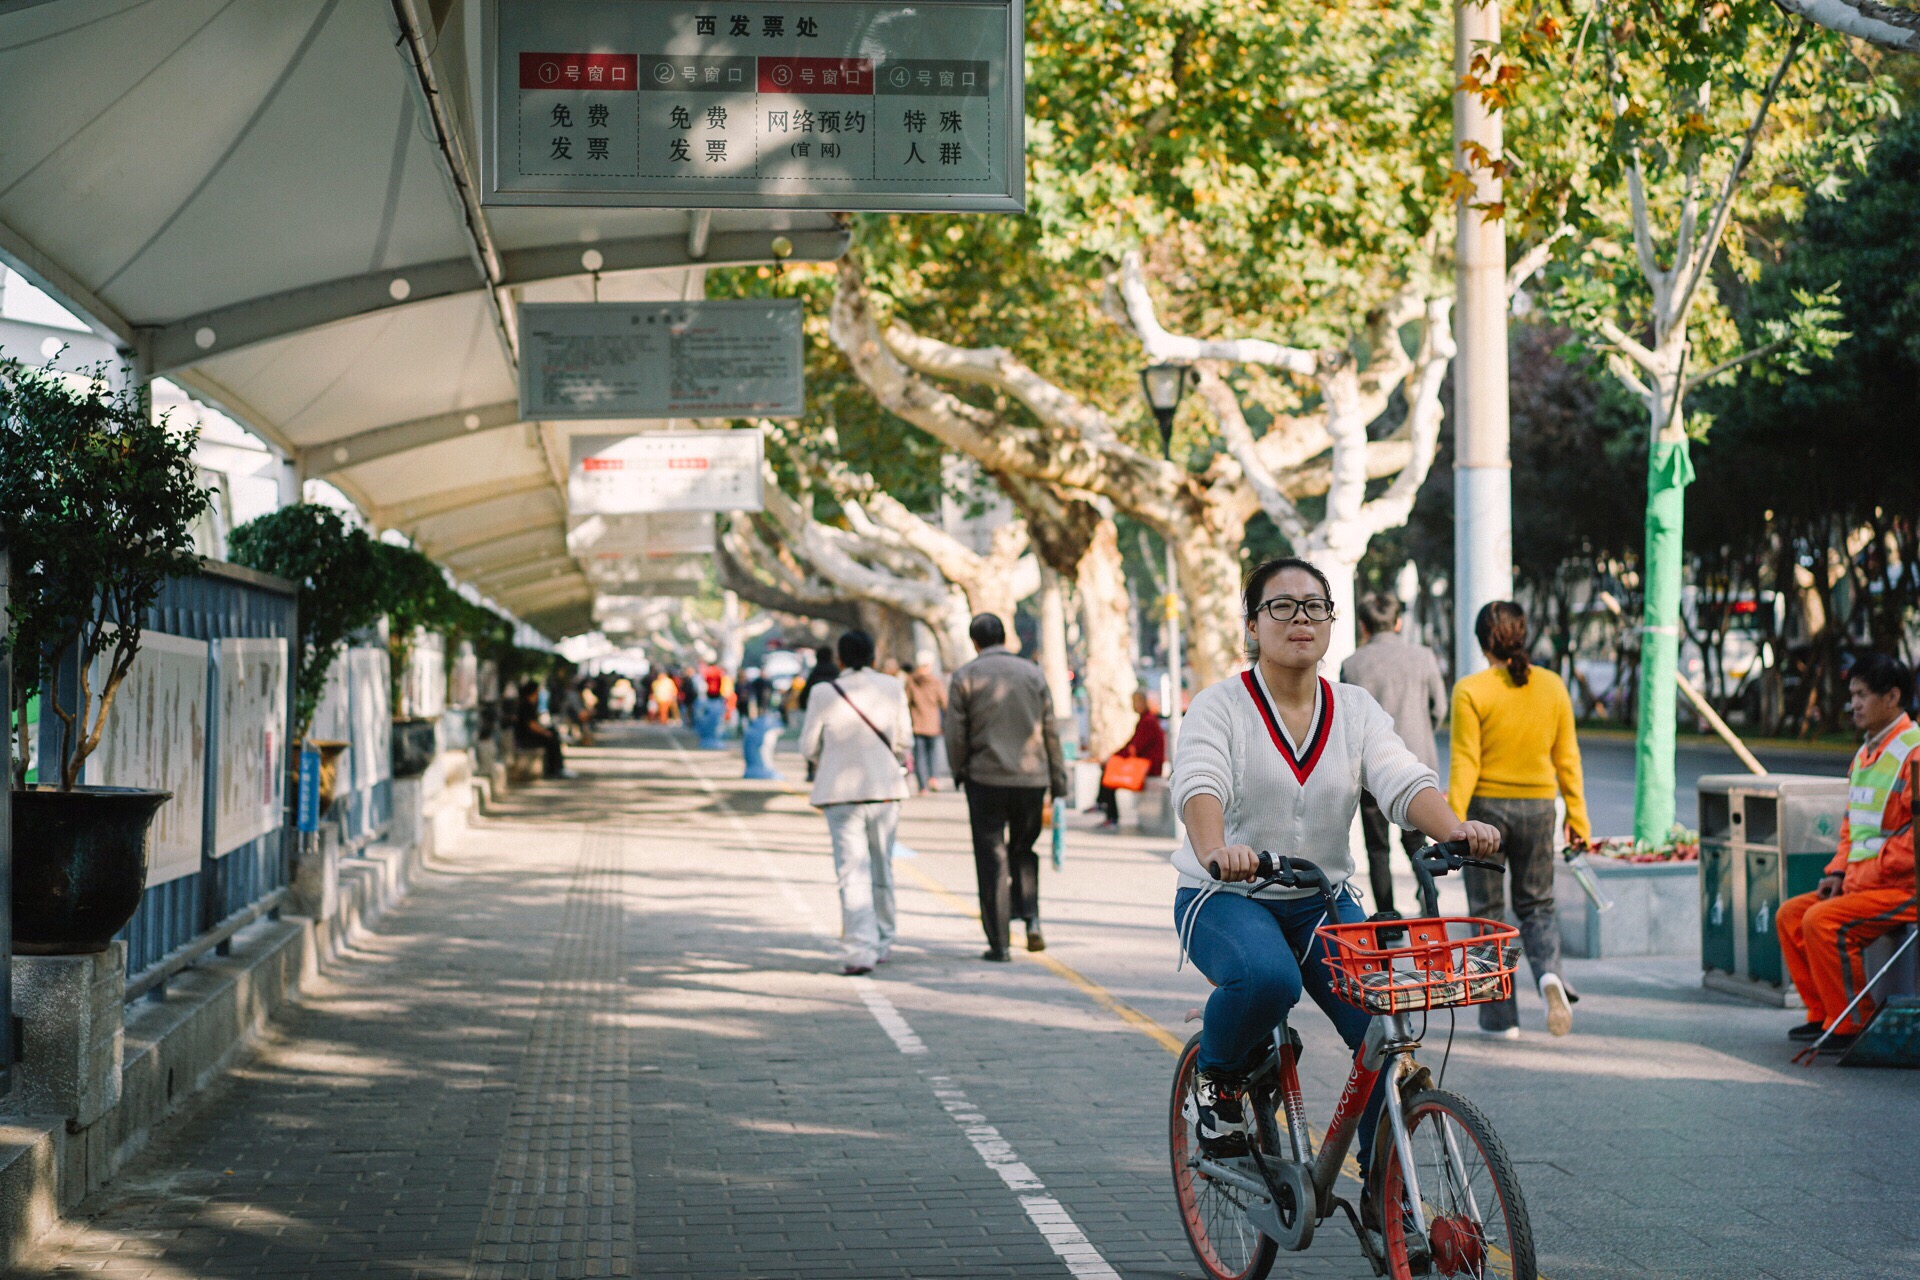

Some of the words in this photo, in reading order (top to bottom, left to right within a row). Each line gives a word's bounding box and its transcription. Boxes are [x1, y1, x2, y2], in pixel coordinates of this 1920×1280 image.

[695, 15, 819, 38] 西发票处
[549, 103, 610, 129] 免费
[667, 105, 728, 130] 免费
[767, 109, 867, 135] 网络预约
[903, 109, 963, 135] 特殊
[550, 136, 610, 161] 发票
[668, 138, 728, 163] 发票
[790, 142, 841, 159] (官网)
[903, 141, 963, 166] 人群
